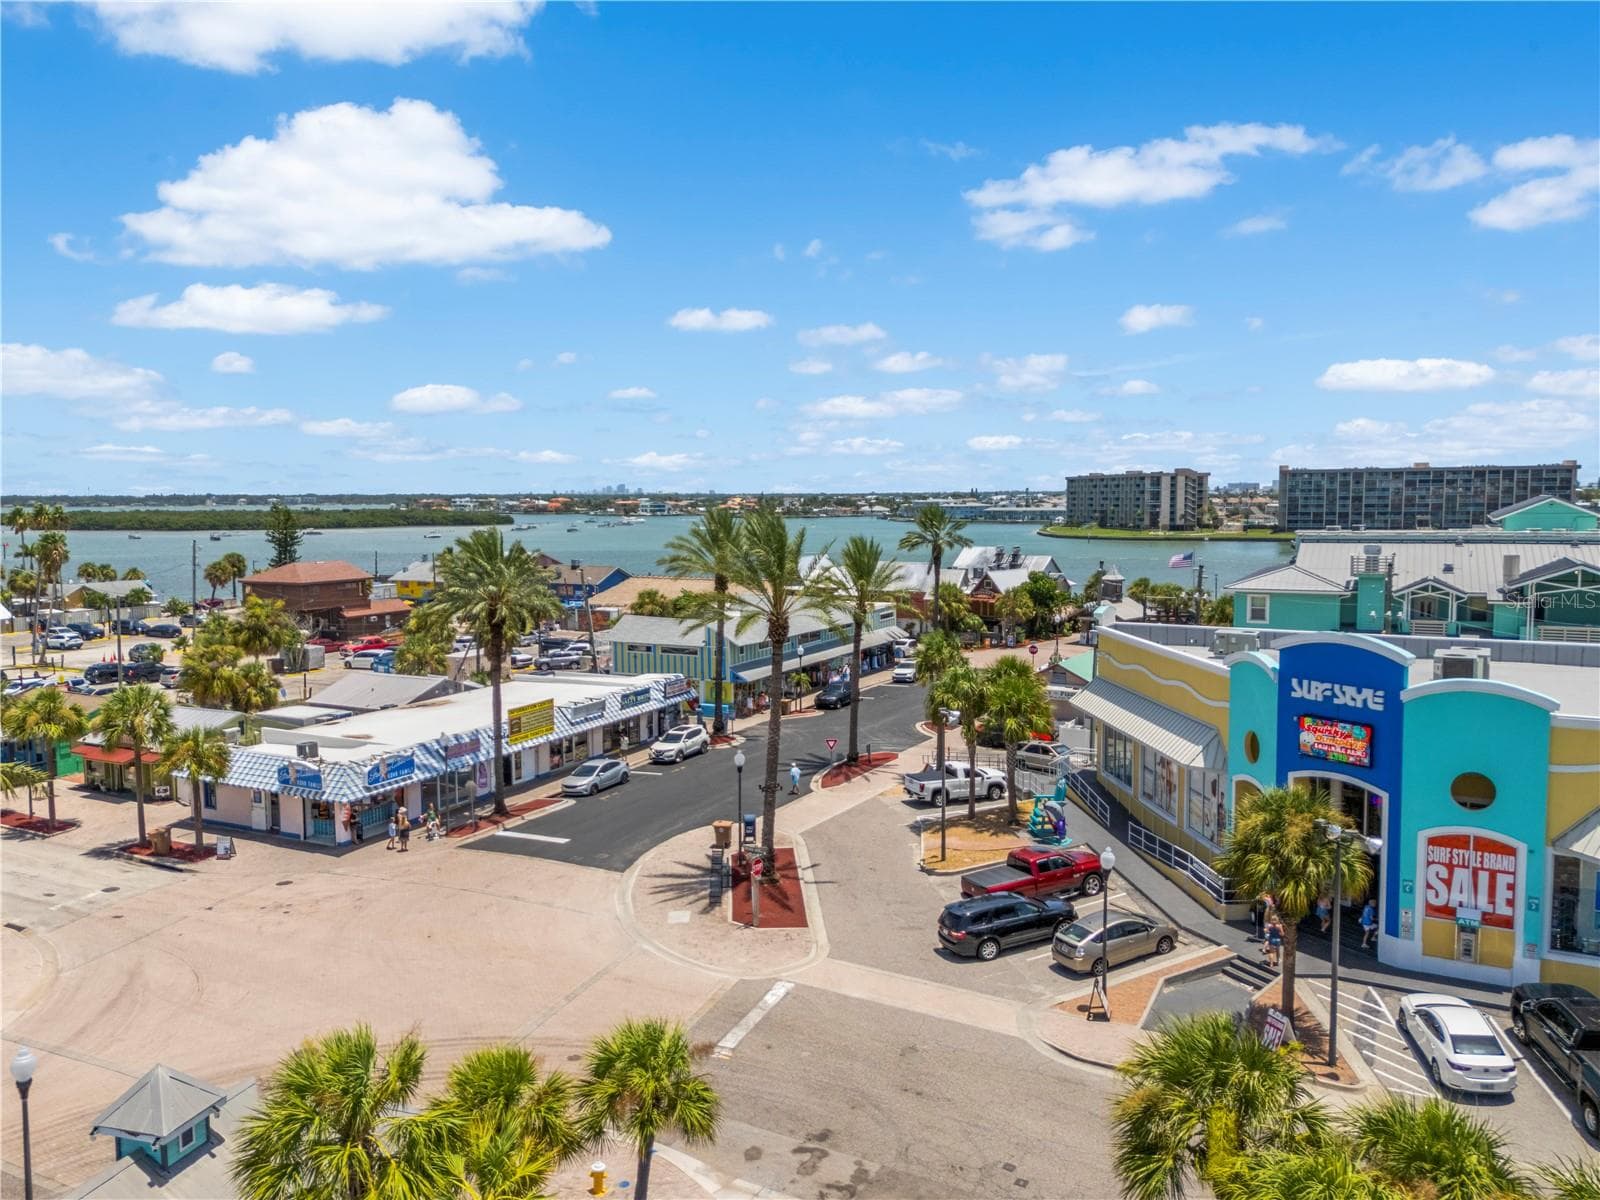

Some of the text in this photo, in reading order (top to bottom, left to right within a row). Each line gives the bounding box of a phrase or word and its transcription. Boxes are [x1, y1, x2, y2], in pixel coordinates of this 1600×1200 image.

[1291, 677, 1385, 711] SURF STYLE
[1427, 845, 1516, 872] SURF STYLE BRAND
[1426, 864, 1514, 916] SALE
[1457, 917, 1480, 927] ATM
